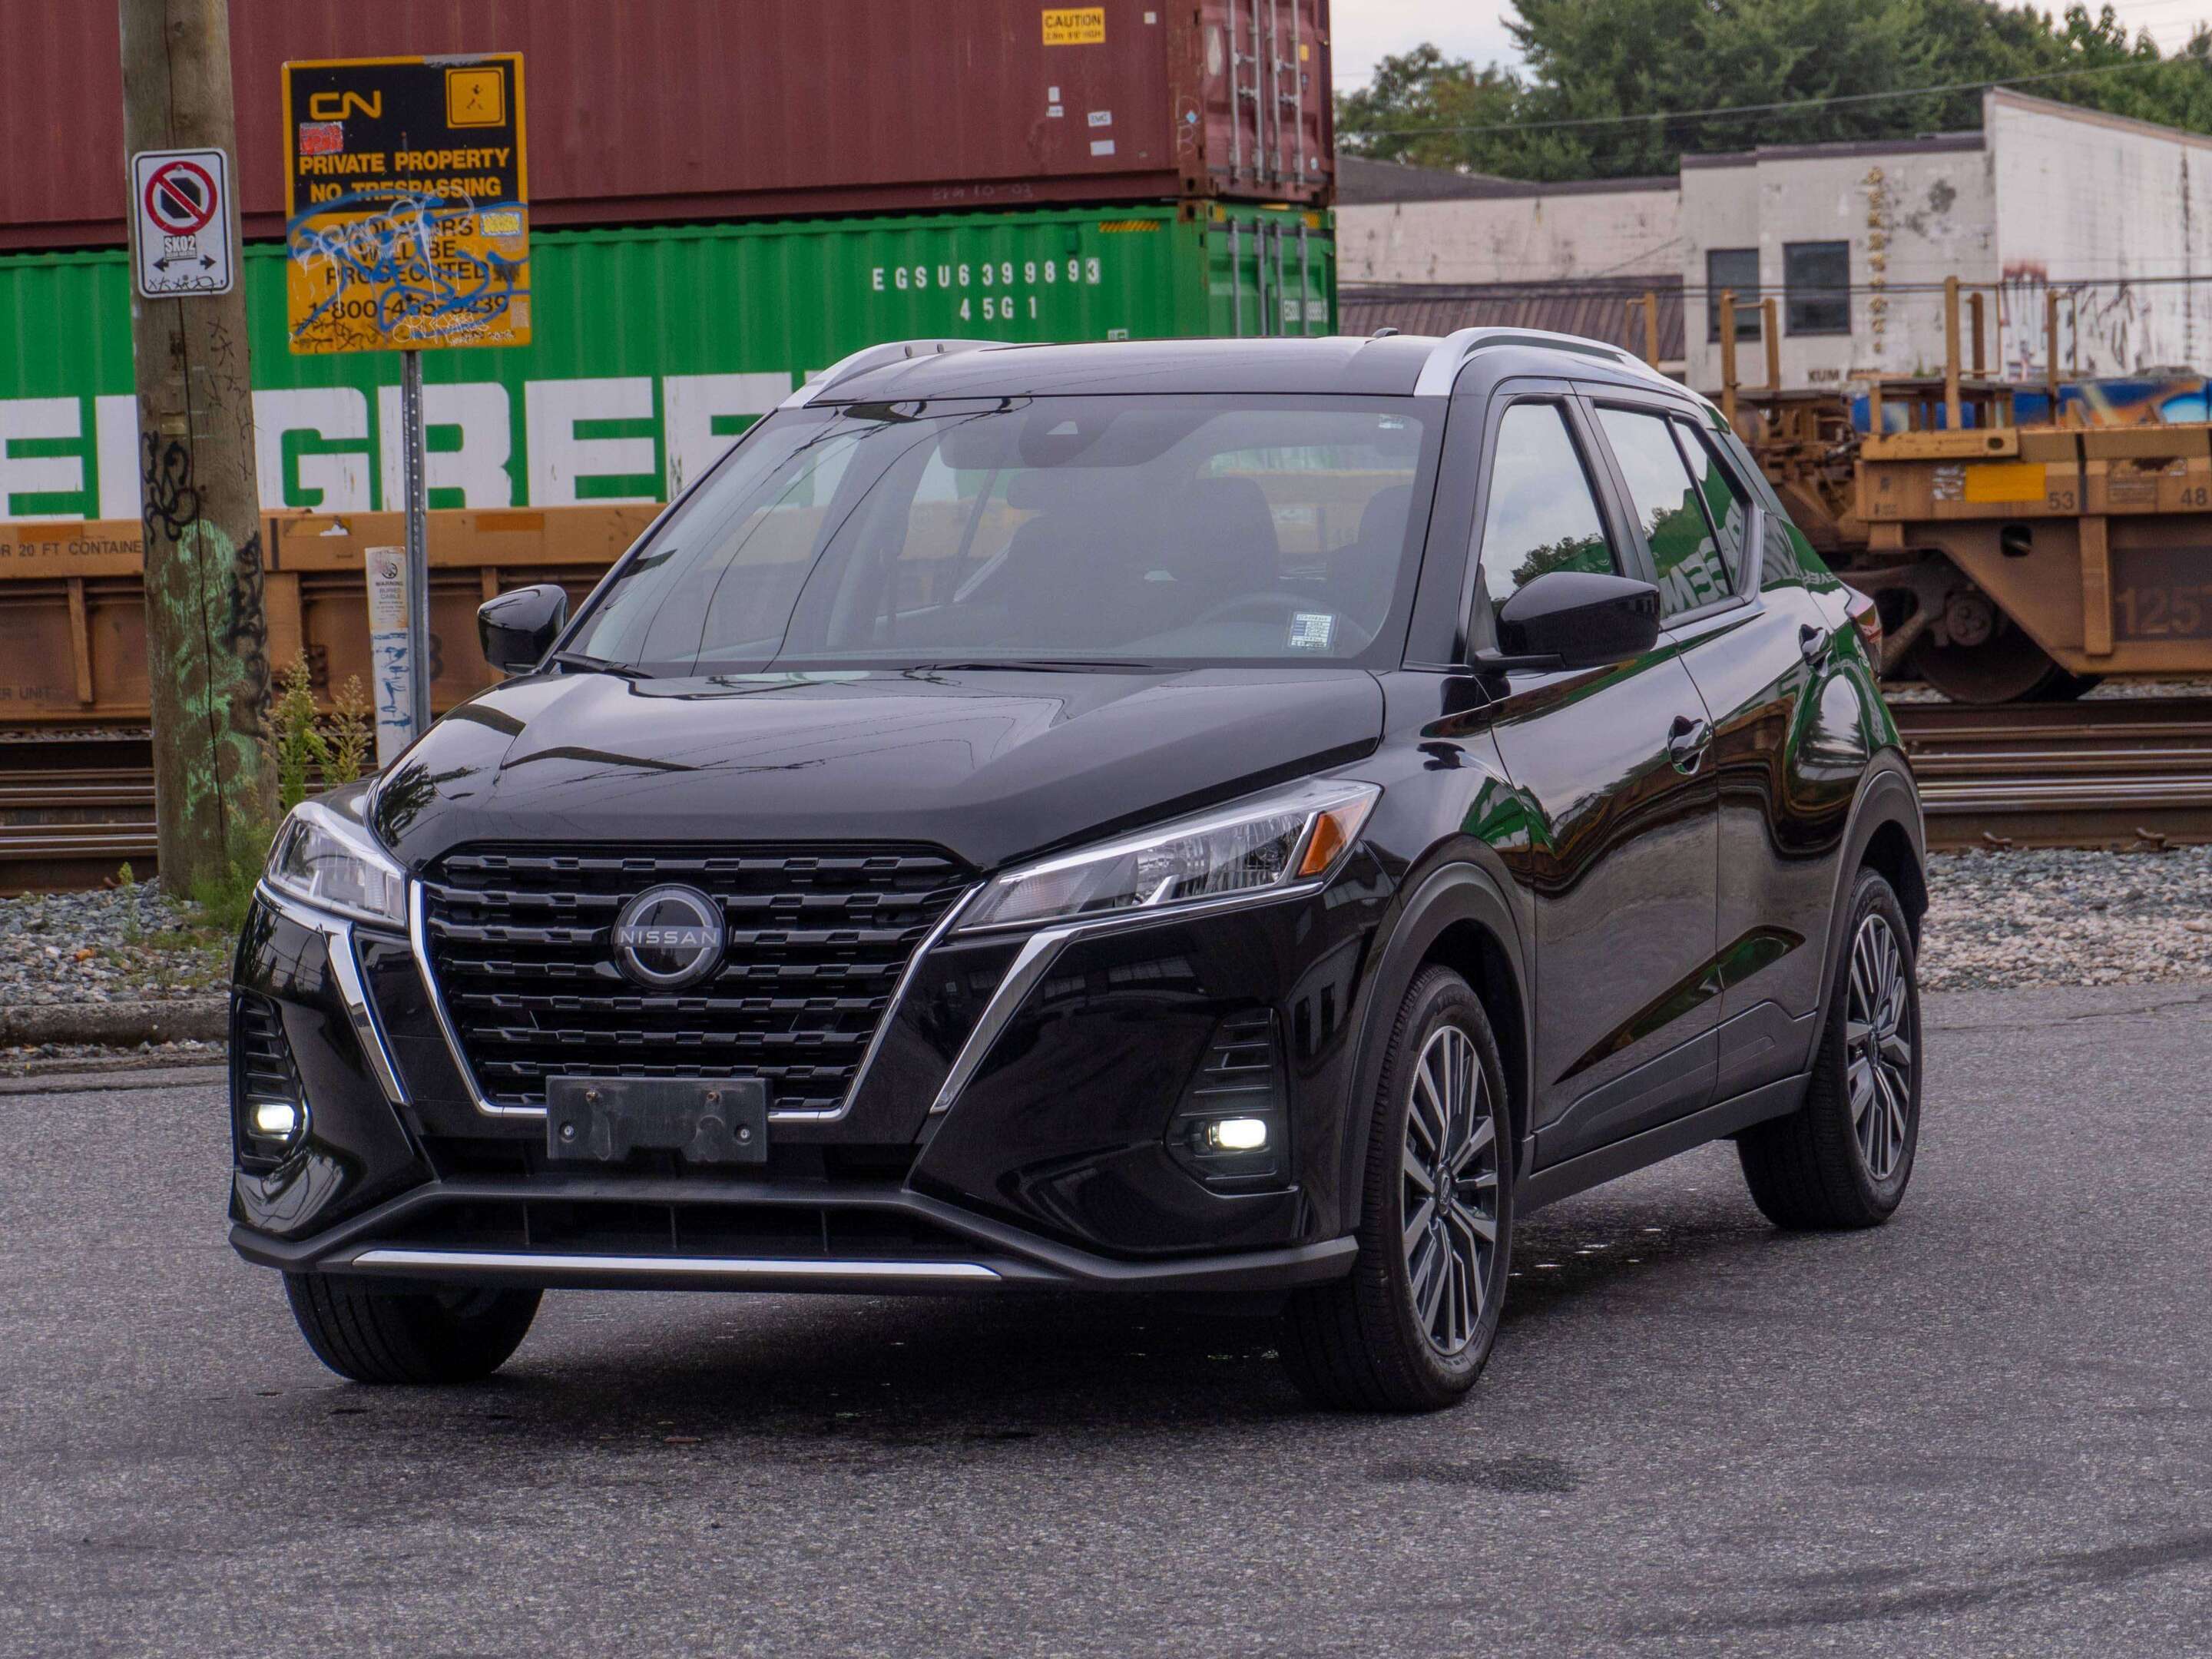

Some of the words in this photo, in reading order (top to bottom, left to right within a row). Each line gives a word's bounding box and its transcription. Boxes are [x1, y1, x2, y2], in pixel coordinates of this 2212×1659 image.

[1045, 14, 1101, 28] CAUTION
[310, 89, 382, 120] CN
[299, 153, 385, 175] PRIVATE
[394, 147, 510, 171] PROPERTY
[310, 182, 342, 204] NO
[351, 177, 502, 201] TRESPASSING
[326, 261, 489, 285] PROSECTED
[2048, 492, 2075, 510] 53
[2181, 488, 2207, 506] 48
[18, 544, 35, 557] 20
[42, 543, 61, 555] FT
[68, 540, 143, 555] CONTAINE
[620, 930, 717, 945] NISSAN
